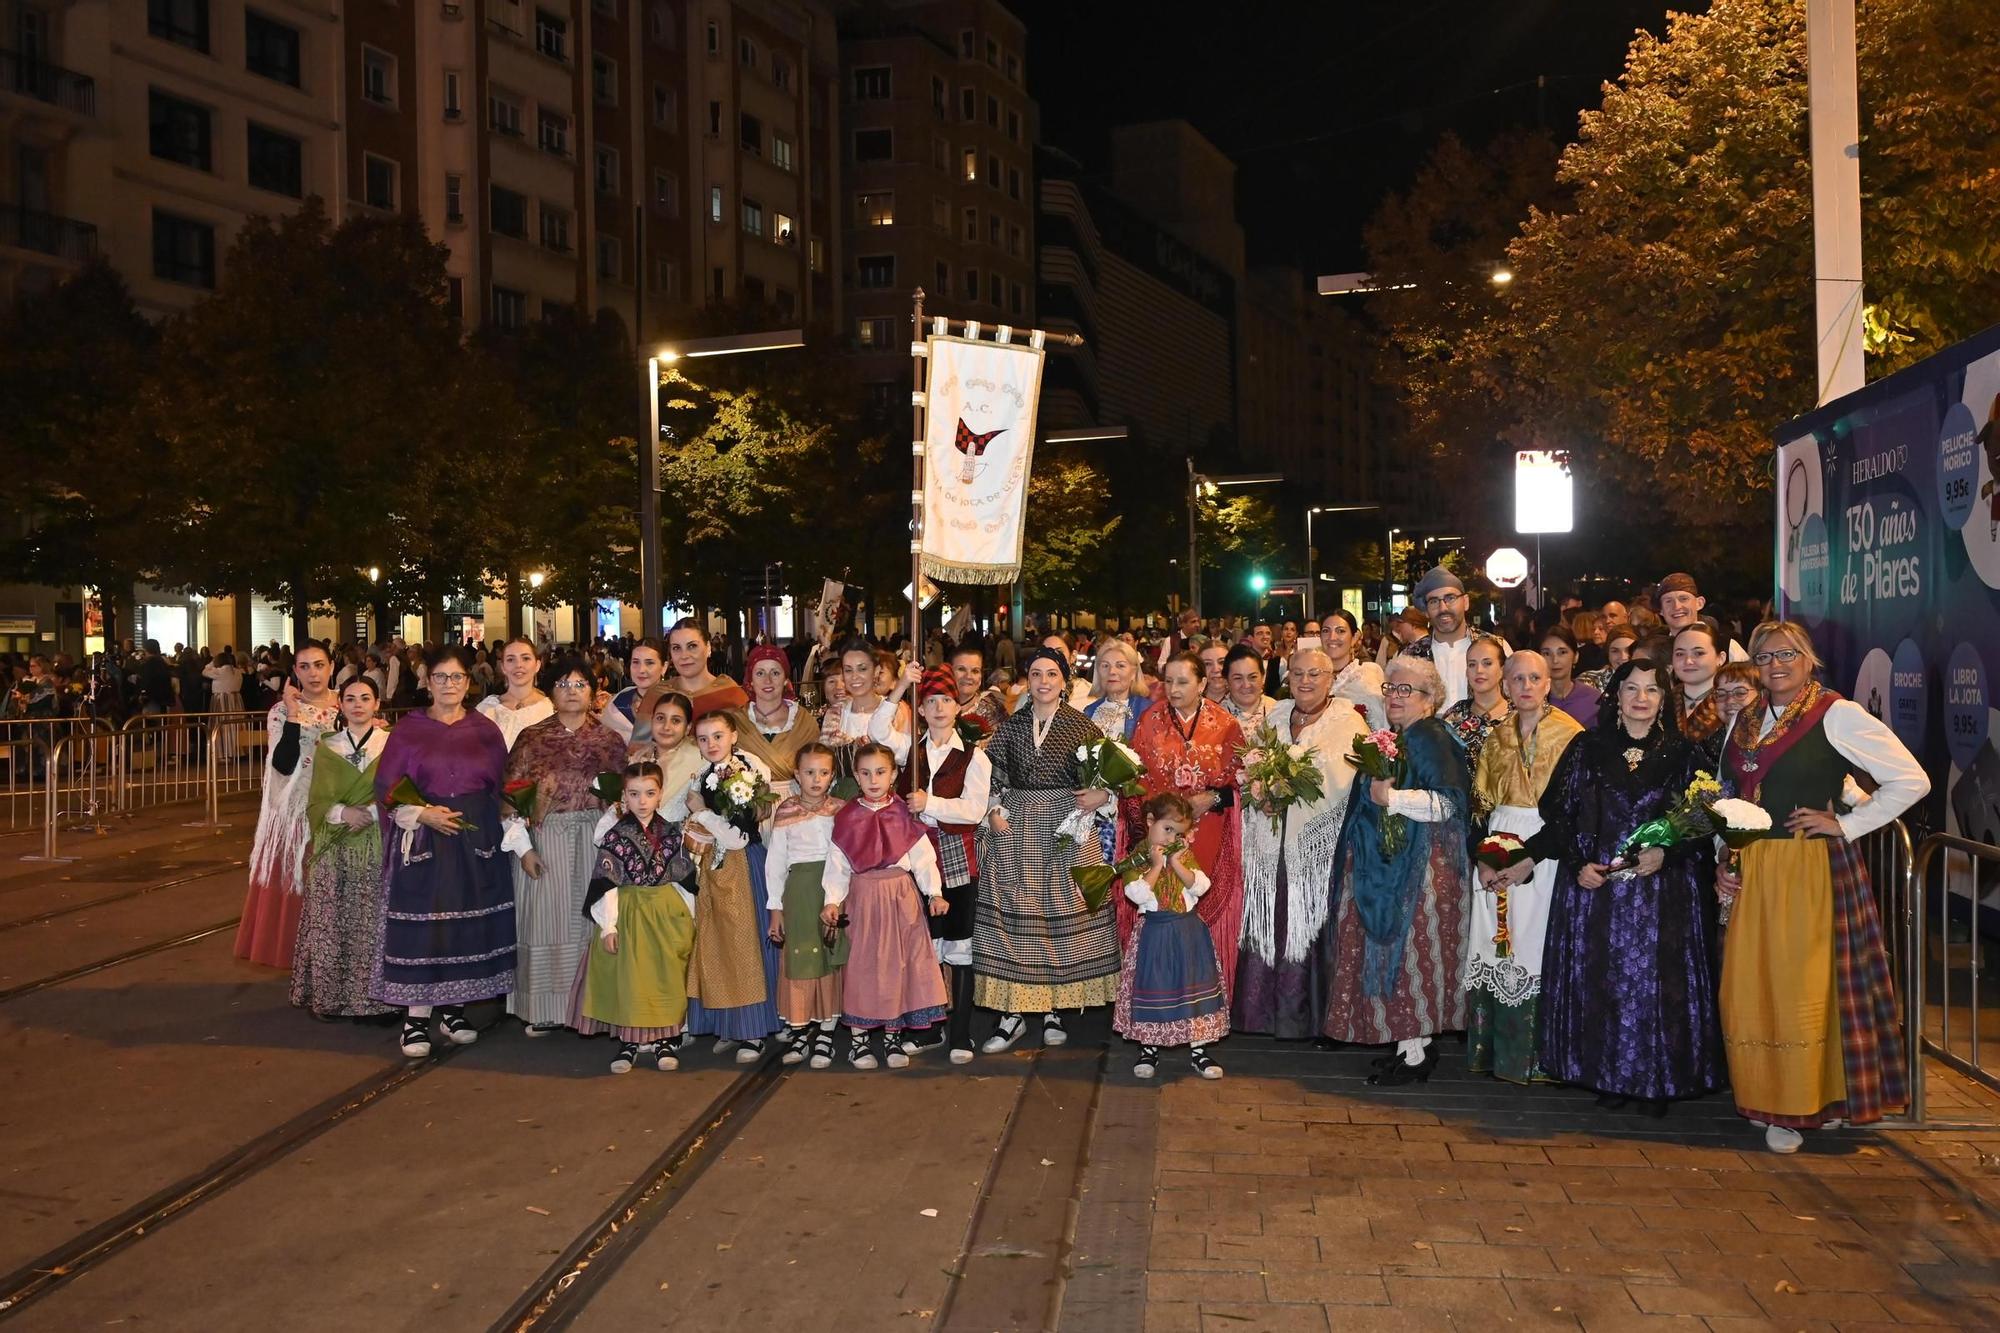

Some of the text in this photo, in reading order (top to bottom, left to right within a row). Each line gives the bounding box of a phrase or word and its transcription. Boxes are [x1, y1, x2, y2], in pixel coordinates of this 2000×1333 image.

[963, 401, 993, 414] A.C.
[1942, 430, 1974, 455] PELUCHE
[1852, 450, 1896, 485] HERALDO
[1943, 450, 1972, 472] MORICO
[1946, 478, 1969, 504] 9,95€
[1846, 501, 1916, 553] 130 años
[1841, 550, 1920, 605] de Pilares
[1894, 672, 1923, 688] BROCHE
[1953, 668, 1978, 686] LIBRO
[1949, 687, 1983, 705] LA JOTA
